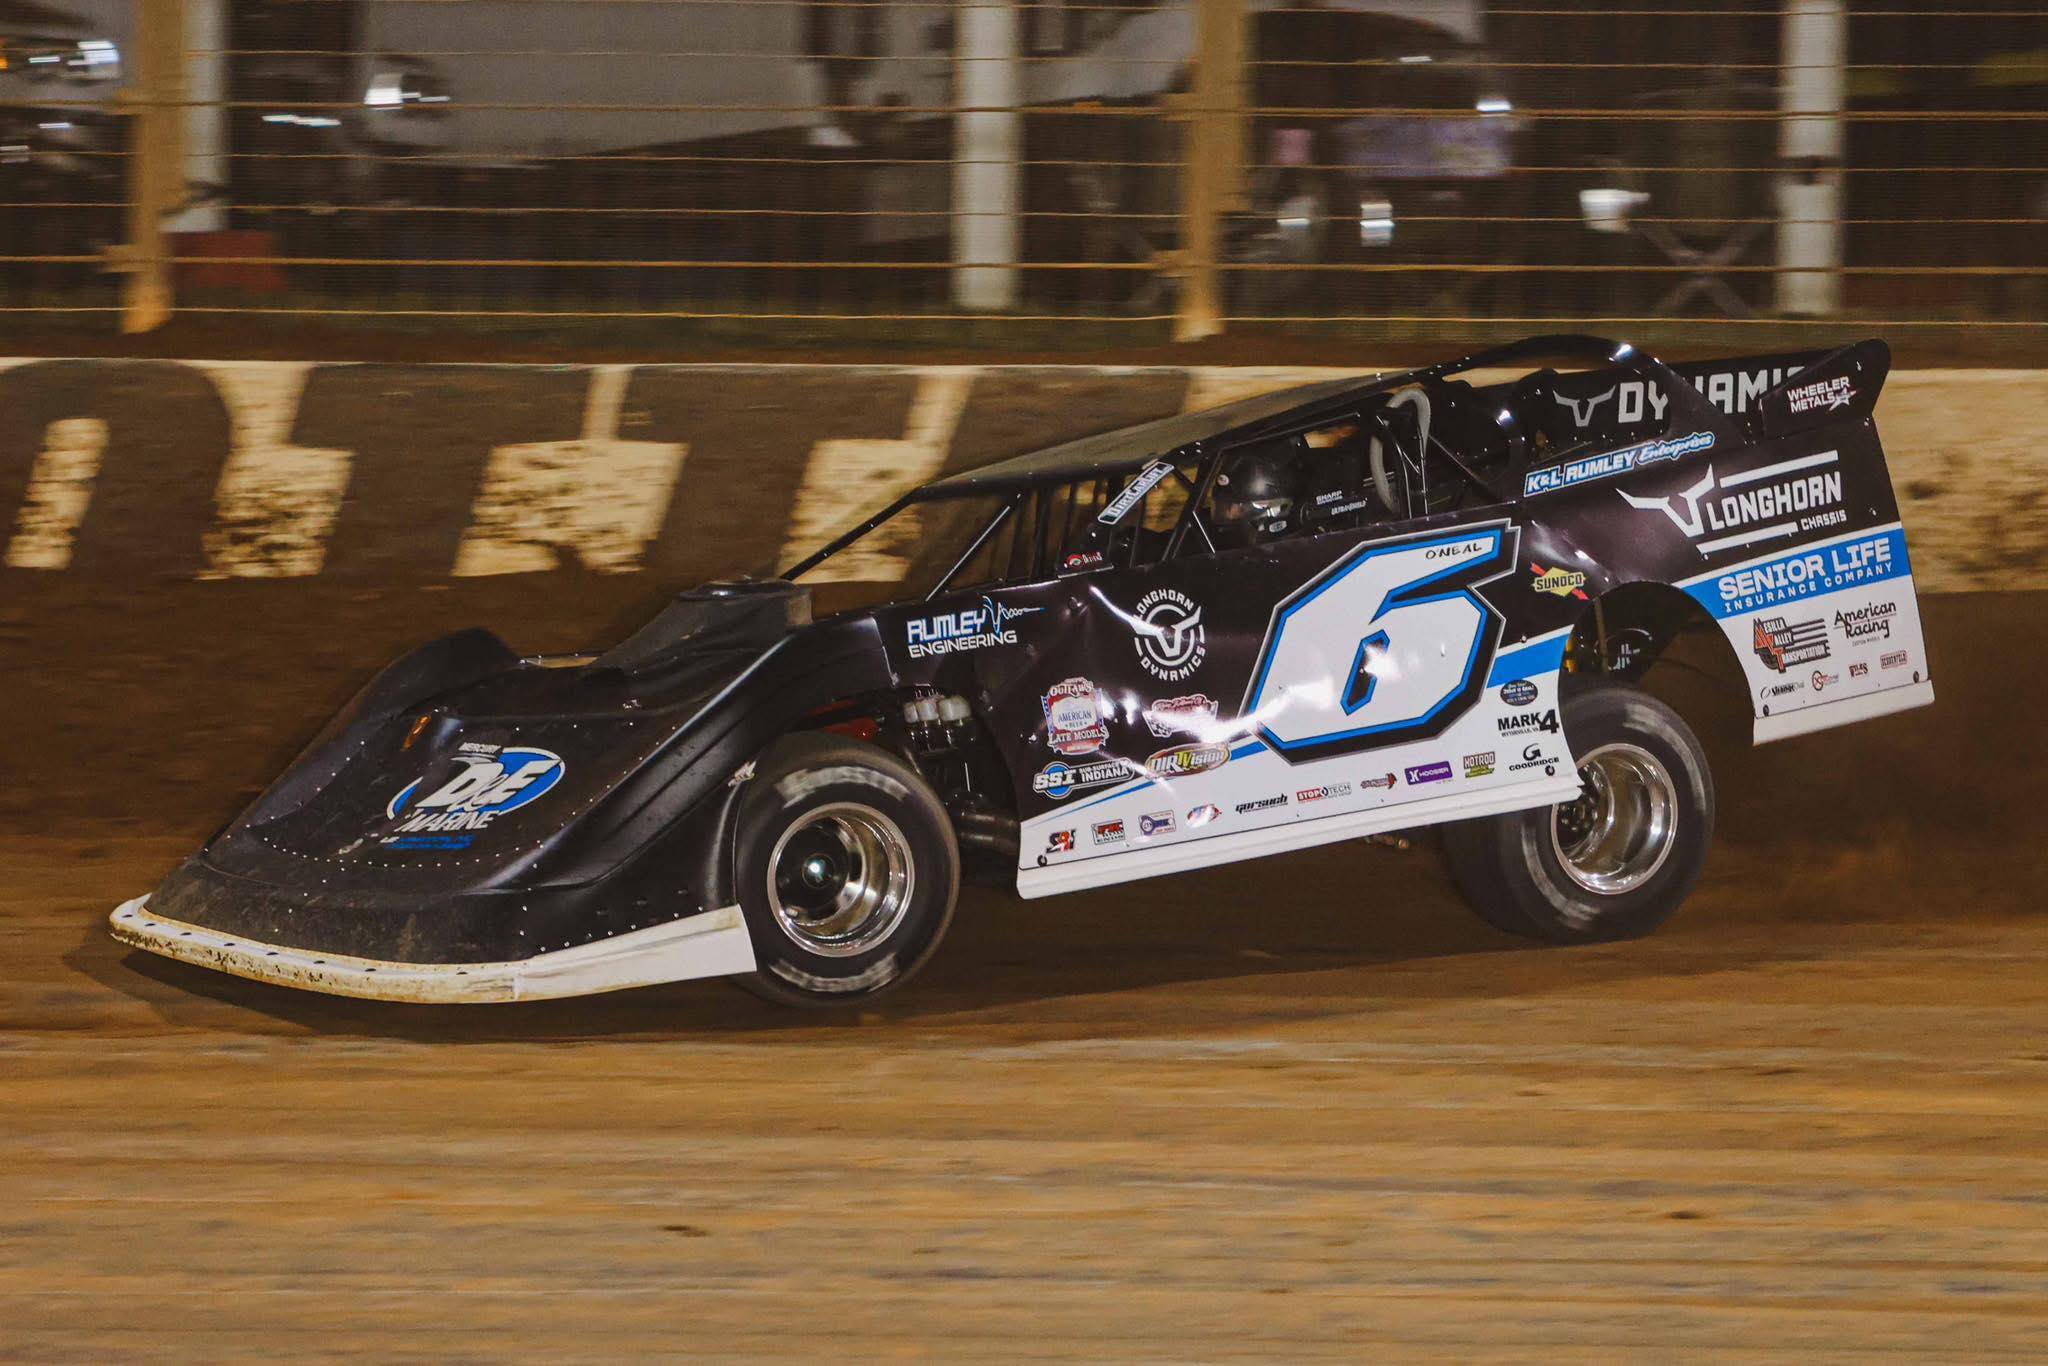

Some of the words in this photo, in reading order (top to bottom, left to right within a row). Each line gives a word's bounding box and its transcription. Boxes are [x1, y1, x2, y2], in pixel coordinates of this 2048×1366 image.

[1787, 376, 1850, 401] WHEELER
[1790, 393, 1835, 414] METALS
[1527, 472, 1562, 492] K&L
[1566, 451, 1637, 483] RUMLEY
[1639, 433, 1714, 462] Enterprises
[1706, 471, 1842, 532] LONGHORN
[1801, 509, 1848, 531] CHASSIS
[1425, 542, 1482, 560] O'NEAL
[1718, 553, 1826, 600] SENIOR
[1832, 537, 1891, 572] LIFE
[1536, 573, 1583, 592] SUNOCO
[1725, 581, 1816, 613] INSURANCE
[1825, 562, 1894, 588] COMPANY
[906, 608, 987, 643] RUMLEY
[1834, 601, 1897, 627] American
[1250, 529, 1501, 750] 6
[1846, 618, 1891, 639] Racing
[907, 630, 1018, 659] ENGINEERING
[1140, 645, 1206, 682] DYNAMICS
[1050, 680, 1093, 697] OUTLAWS
[1058, 710, 1093, 721] AMERICAN
[1048, 733, 1072, 744] LATE
[1073, 728, 1108, 740] MODELS
[1509, 757, 1560, 772] GOODRIDGE
[1035, 769, 1077, 790] SSI
[1081, 767, 1130, 783] INDIANA
[1297, 788, 1321, 801] STOP
[1328, 785, 1351, 796] TECH
[394, 808, 500, 832] MARINE
